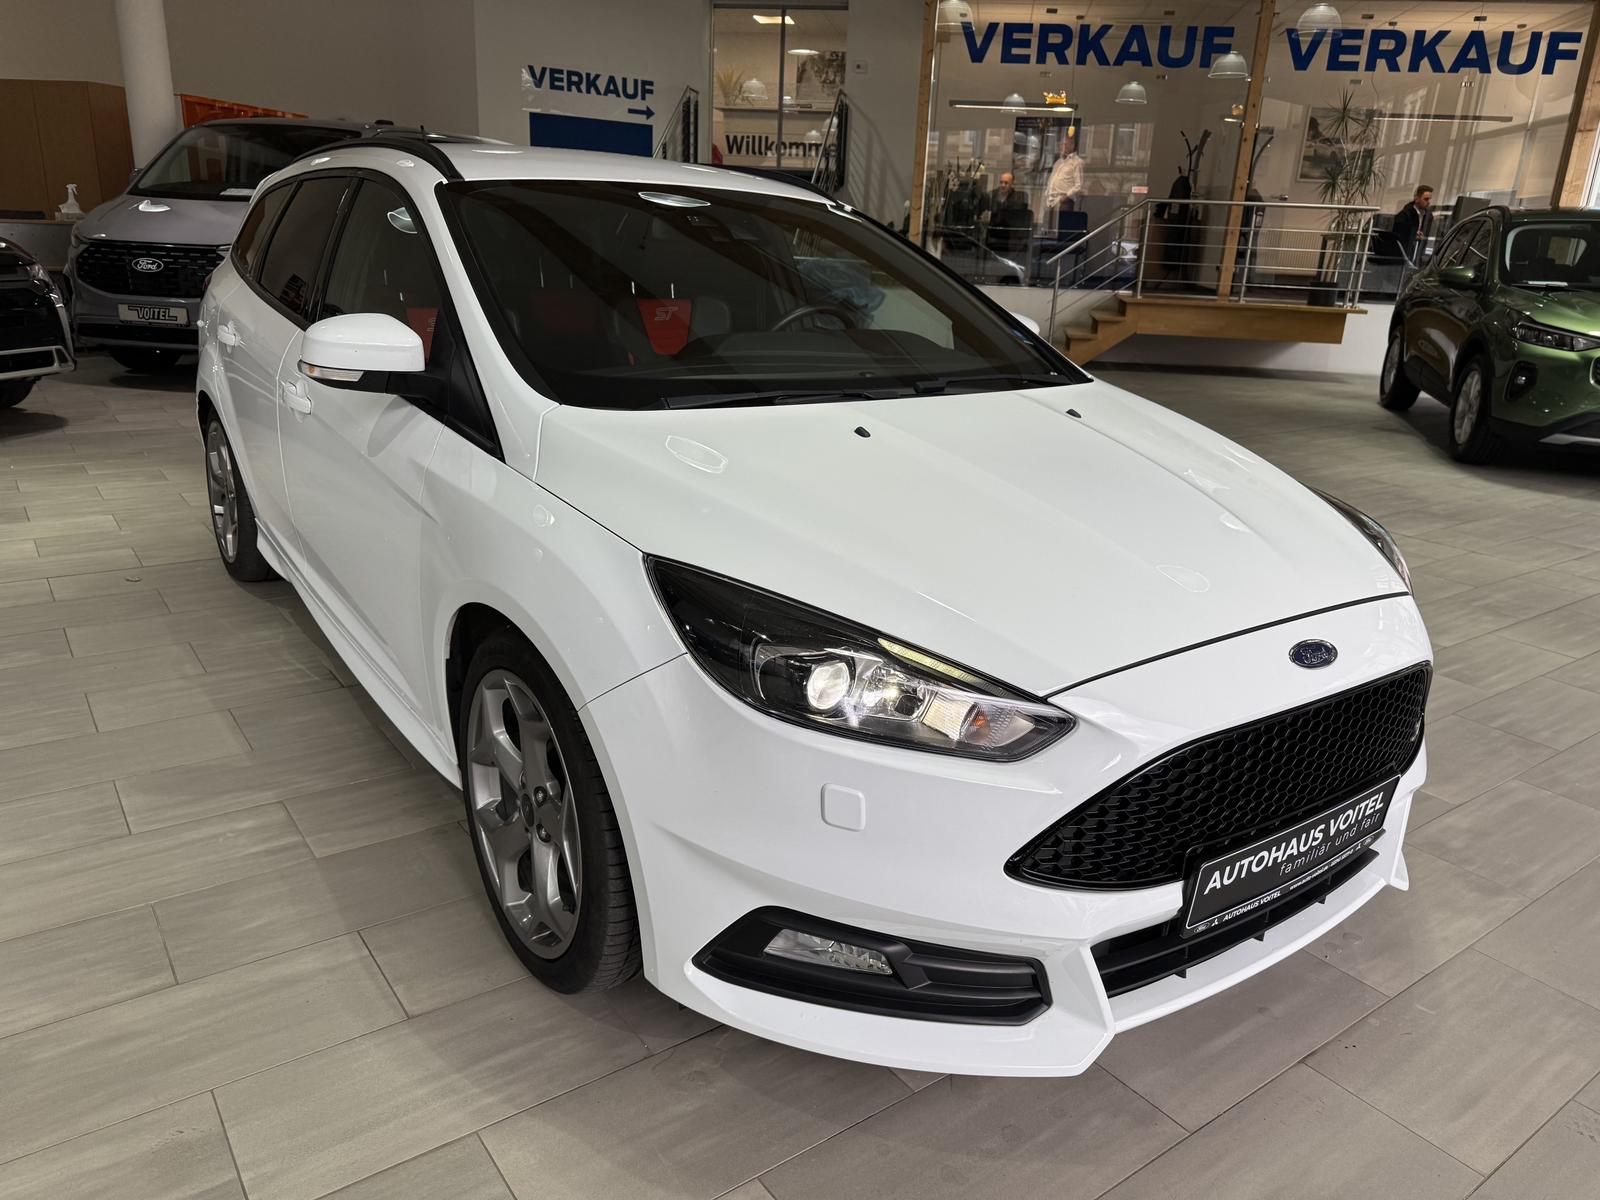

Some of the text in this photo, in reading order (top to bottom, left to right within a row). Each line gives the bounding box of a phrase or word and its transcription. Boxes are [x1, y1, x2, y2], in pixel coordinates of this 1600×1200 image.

[961, 21, 1235, 69] VERKAUF
[1285, 27, 1583, 76] VERKAUF
[527, 64, 654, 101] VERKAUF
[136, 259, 159, 271] Ford
[128, 305, 177, 322] VOITEL
[654, 306, 680, 321] ST
[1203, 791, 1384, 895] AUTOHAUS VOITEL
[1280, 841, 1332, 876] familiär
[1335, 824, 1358, 846] und
[1360, 811, 1381, 831] fair
[1223, 900, 1259, 922] AUTOHAUS
[1260, 890, 1281, 905] VOITEL
